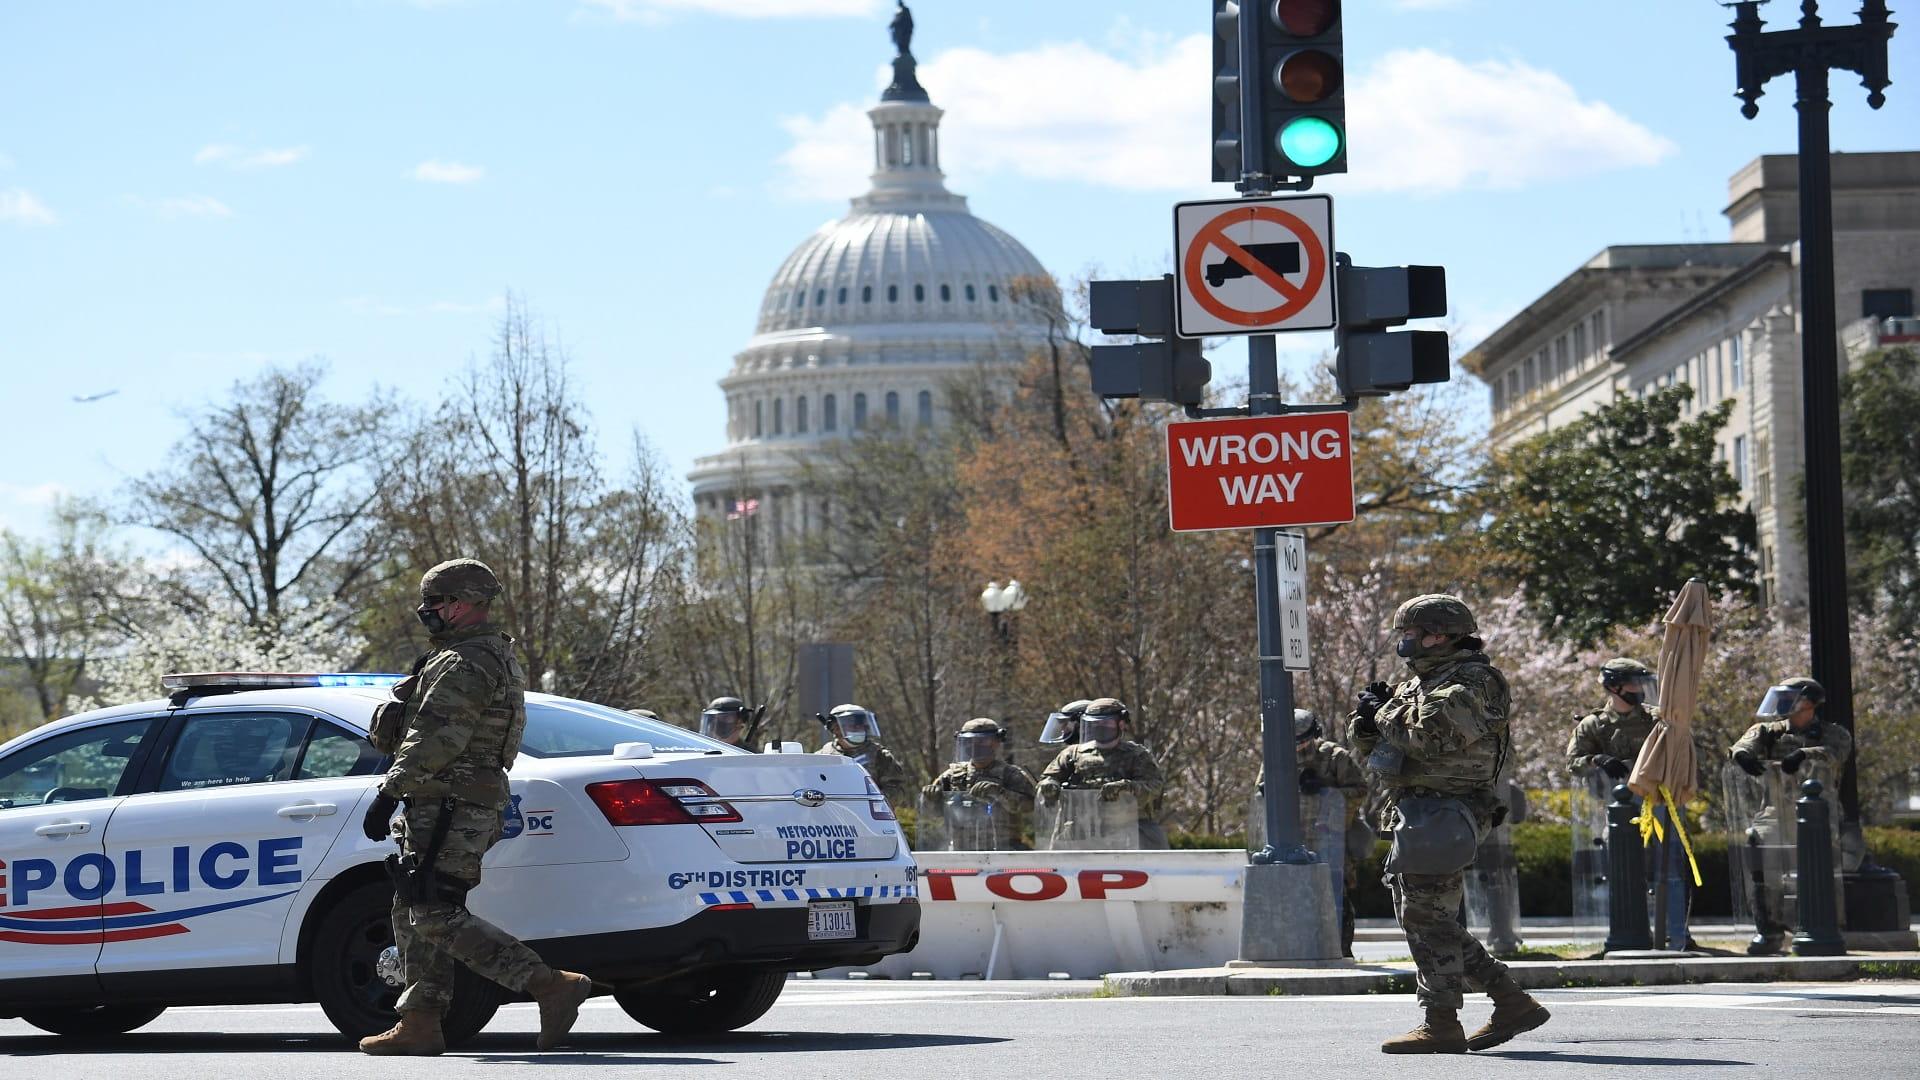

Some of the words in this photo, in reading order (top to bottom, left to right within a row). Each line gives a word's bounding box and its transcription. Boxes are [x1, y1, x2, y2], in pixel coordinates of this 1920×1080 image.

[1178, 428, 1342, 467] WRONG
[1218, 472, 1304, 506] WAY
[1284, 547, 1298, 572] NO
[1284, 580, 1302, 600] TURN
[1289, 609, 1299, 629] ON
[1290, 638, 1302, 658] RED
[235, 775, 251, 783] help
[527, 815, 553, 831] DC
[776, 824, 859, 839] METROPOLITAN
[786, 839, 856, 860] POLICE
[12, 836, 303, 906] POLICE
[668, 871, 706, 890] 6TH
[709, 869, 806, 888] DISTRICT
[918, 869, 1149, 901] TOP
[823, 911, 851, 930] 13014
